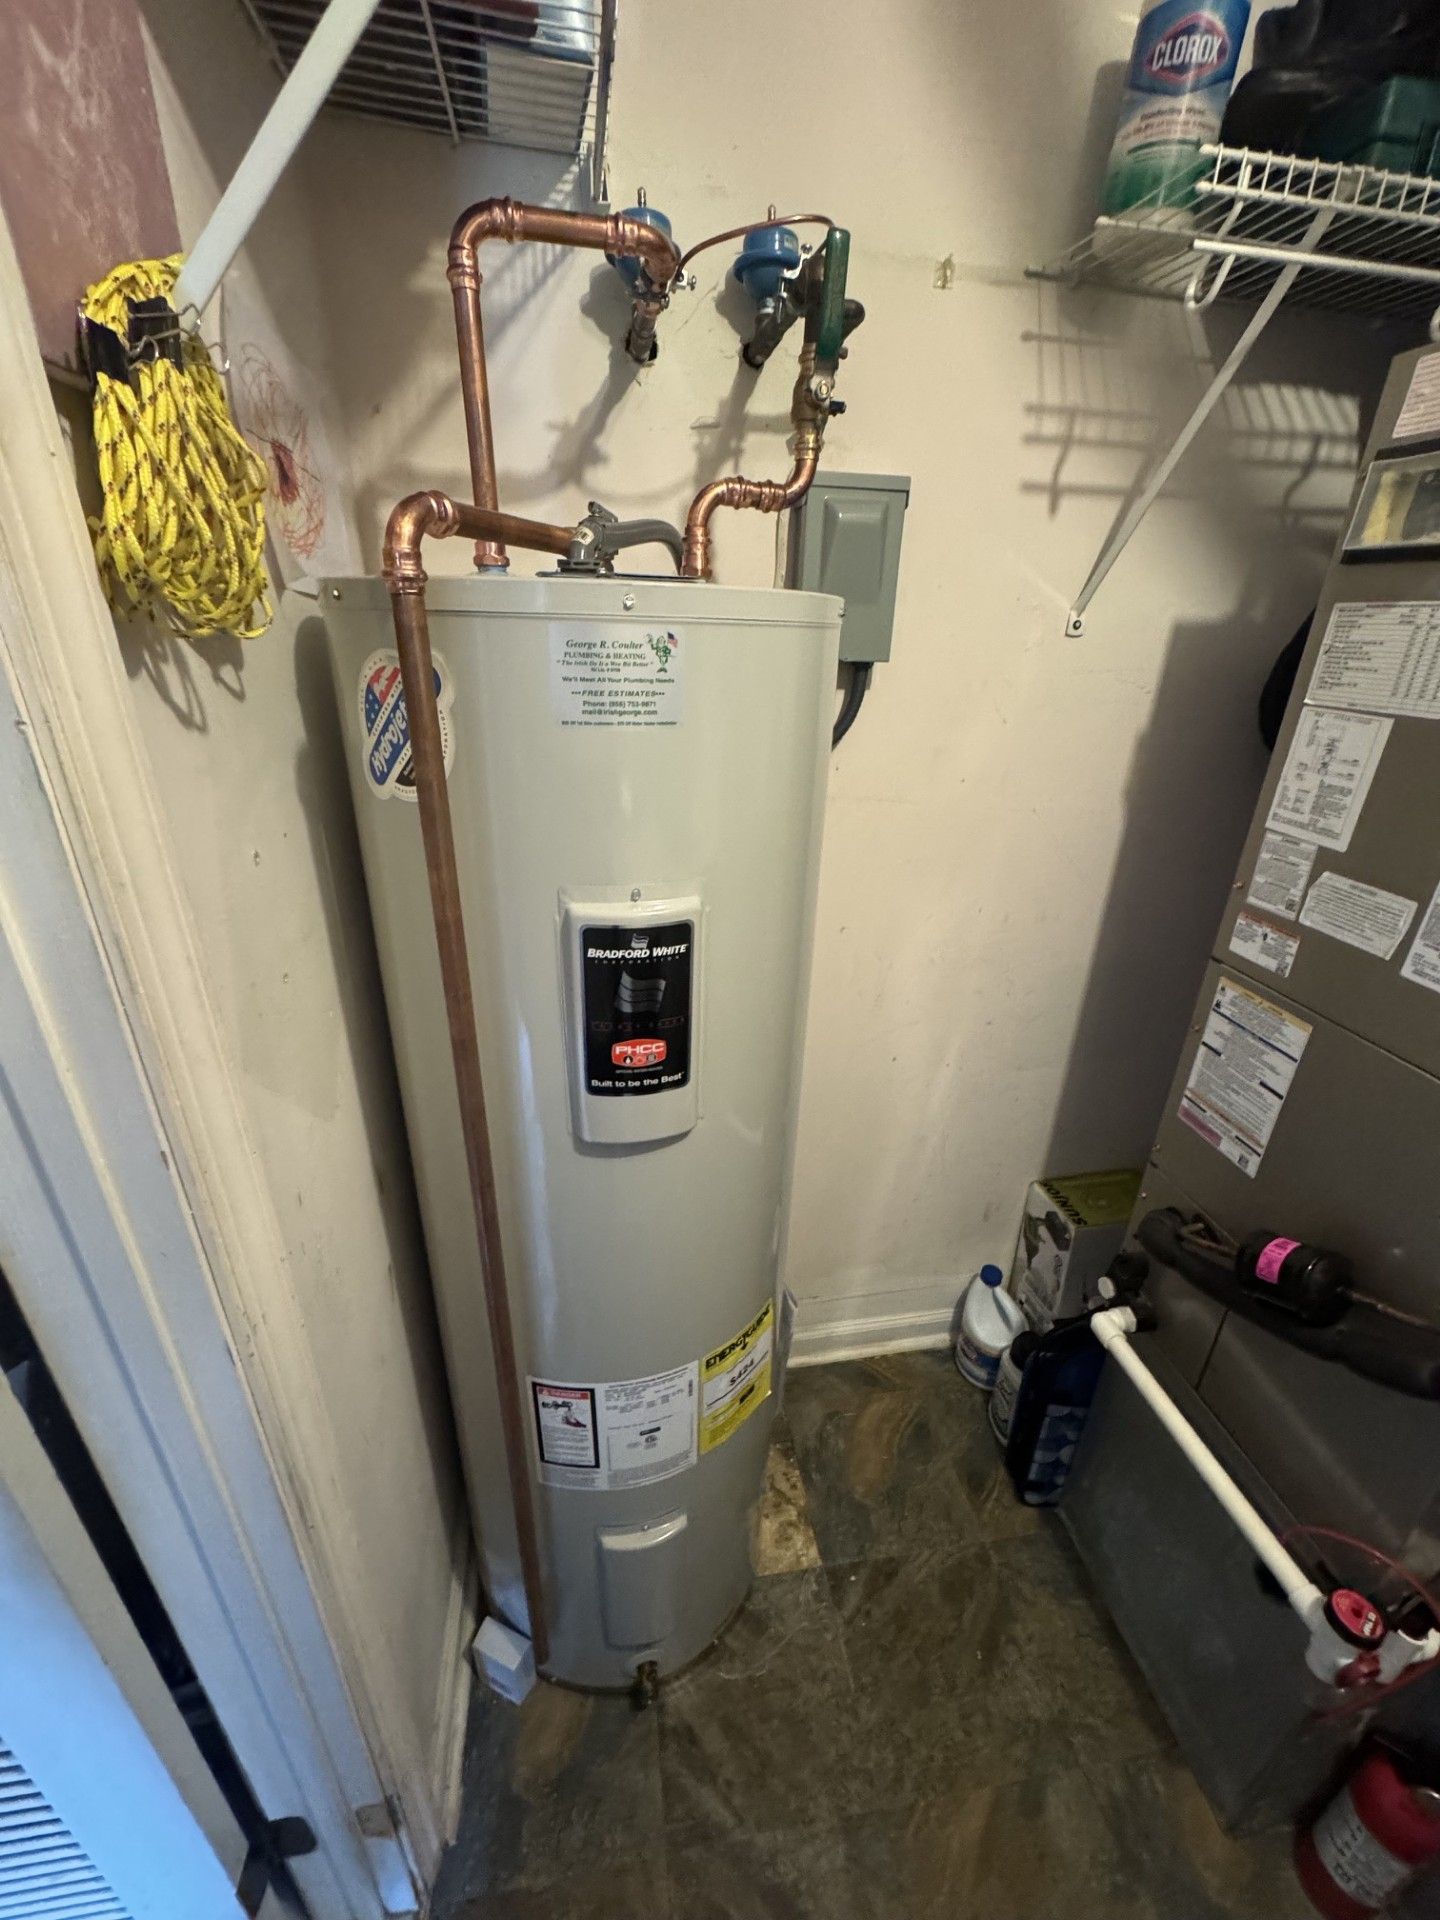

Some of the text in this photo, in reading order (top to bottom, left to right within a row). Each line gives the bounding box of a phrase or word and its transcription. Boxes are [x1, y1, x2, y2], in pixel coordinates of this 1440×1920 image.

[1151, 33, 1223, 71] CLOROX
[566, 639, 644, 650] George R. Coulter
[564, 652, 646, 661] PLUMBING & HEATING
[582, 689, 605, 697] FREE
[587, 944, 688, 959] BRADFORD WHITE
[615, 1042, 665, 1055] PHCC
[591, 1079, 613, 1087] Built
[643, 1078, 658, 1086] the
[661, 1073, 682, 1083] Best
